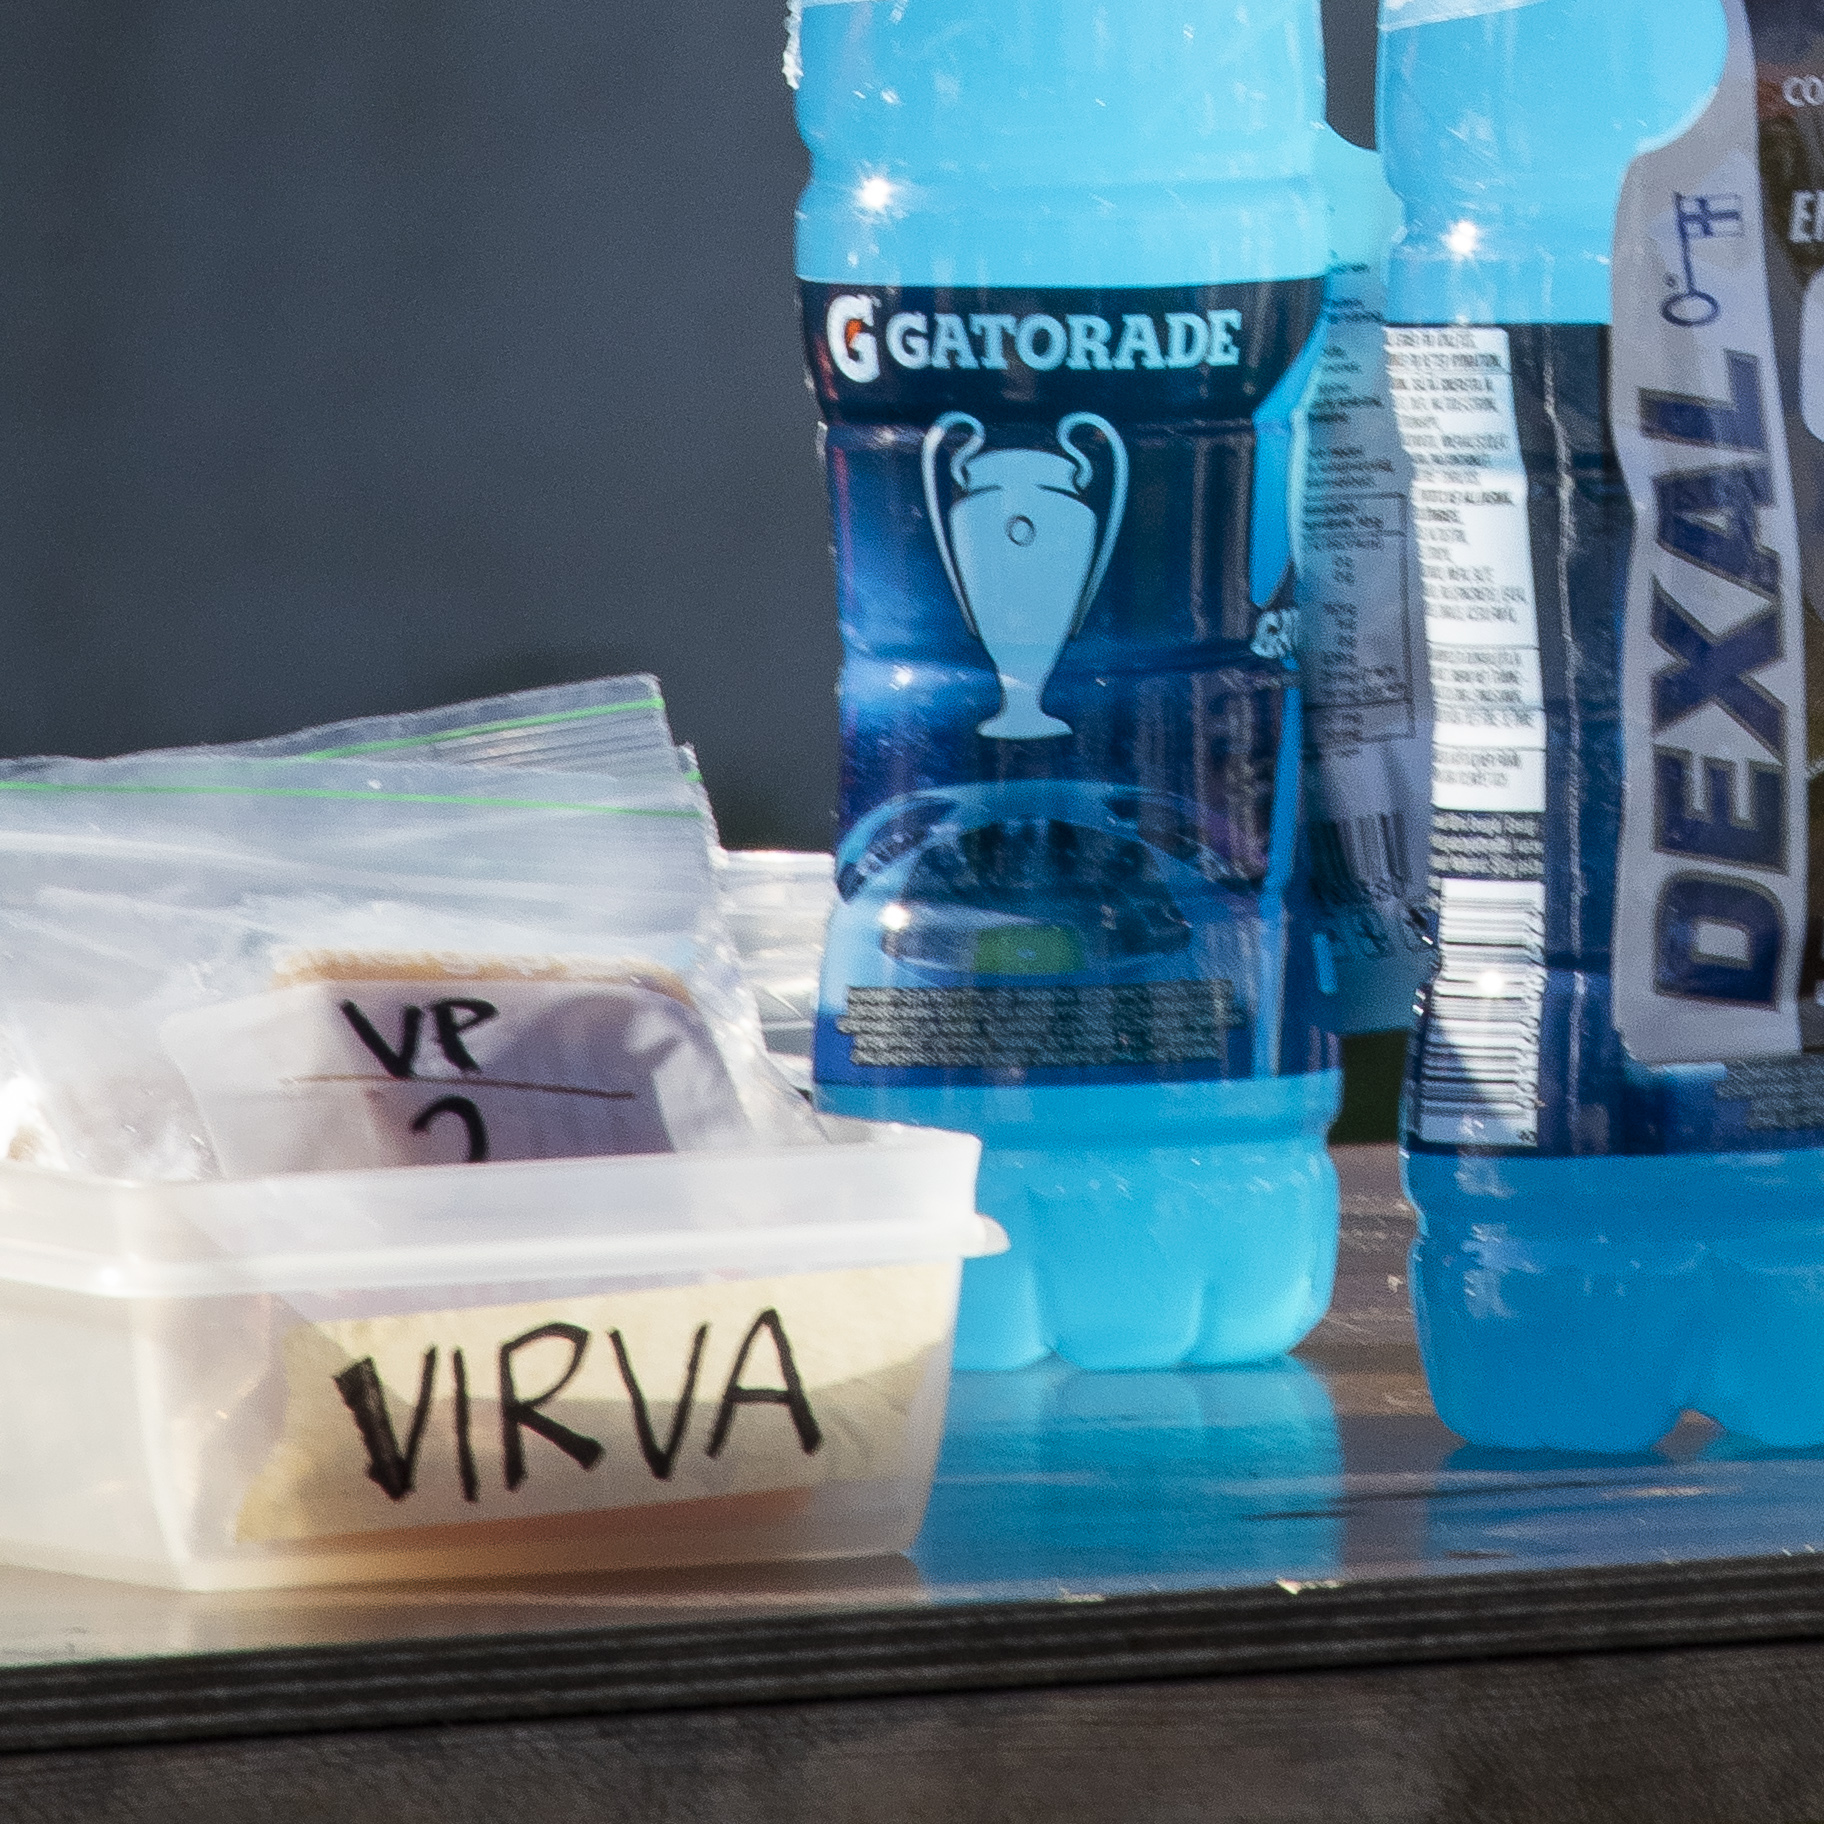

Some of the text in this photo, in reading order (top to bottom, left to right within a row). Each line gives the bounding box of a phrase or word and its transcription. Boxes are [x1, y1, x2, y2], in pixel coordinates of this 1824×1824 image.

[826, 294, 1242, 383] G GATORADE
[1637, 348, 1788, 1013] DEXAL
[341, 999, 498, 1080] VP
[333, 1307, 825, 1502] VIRVA
